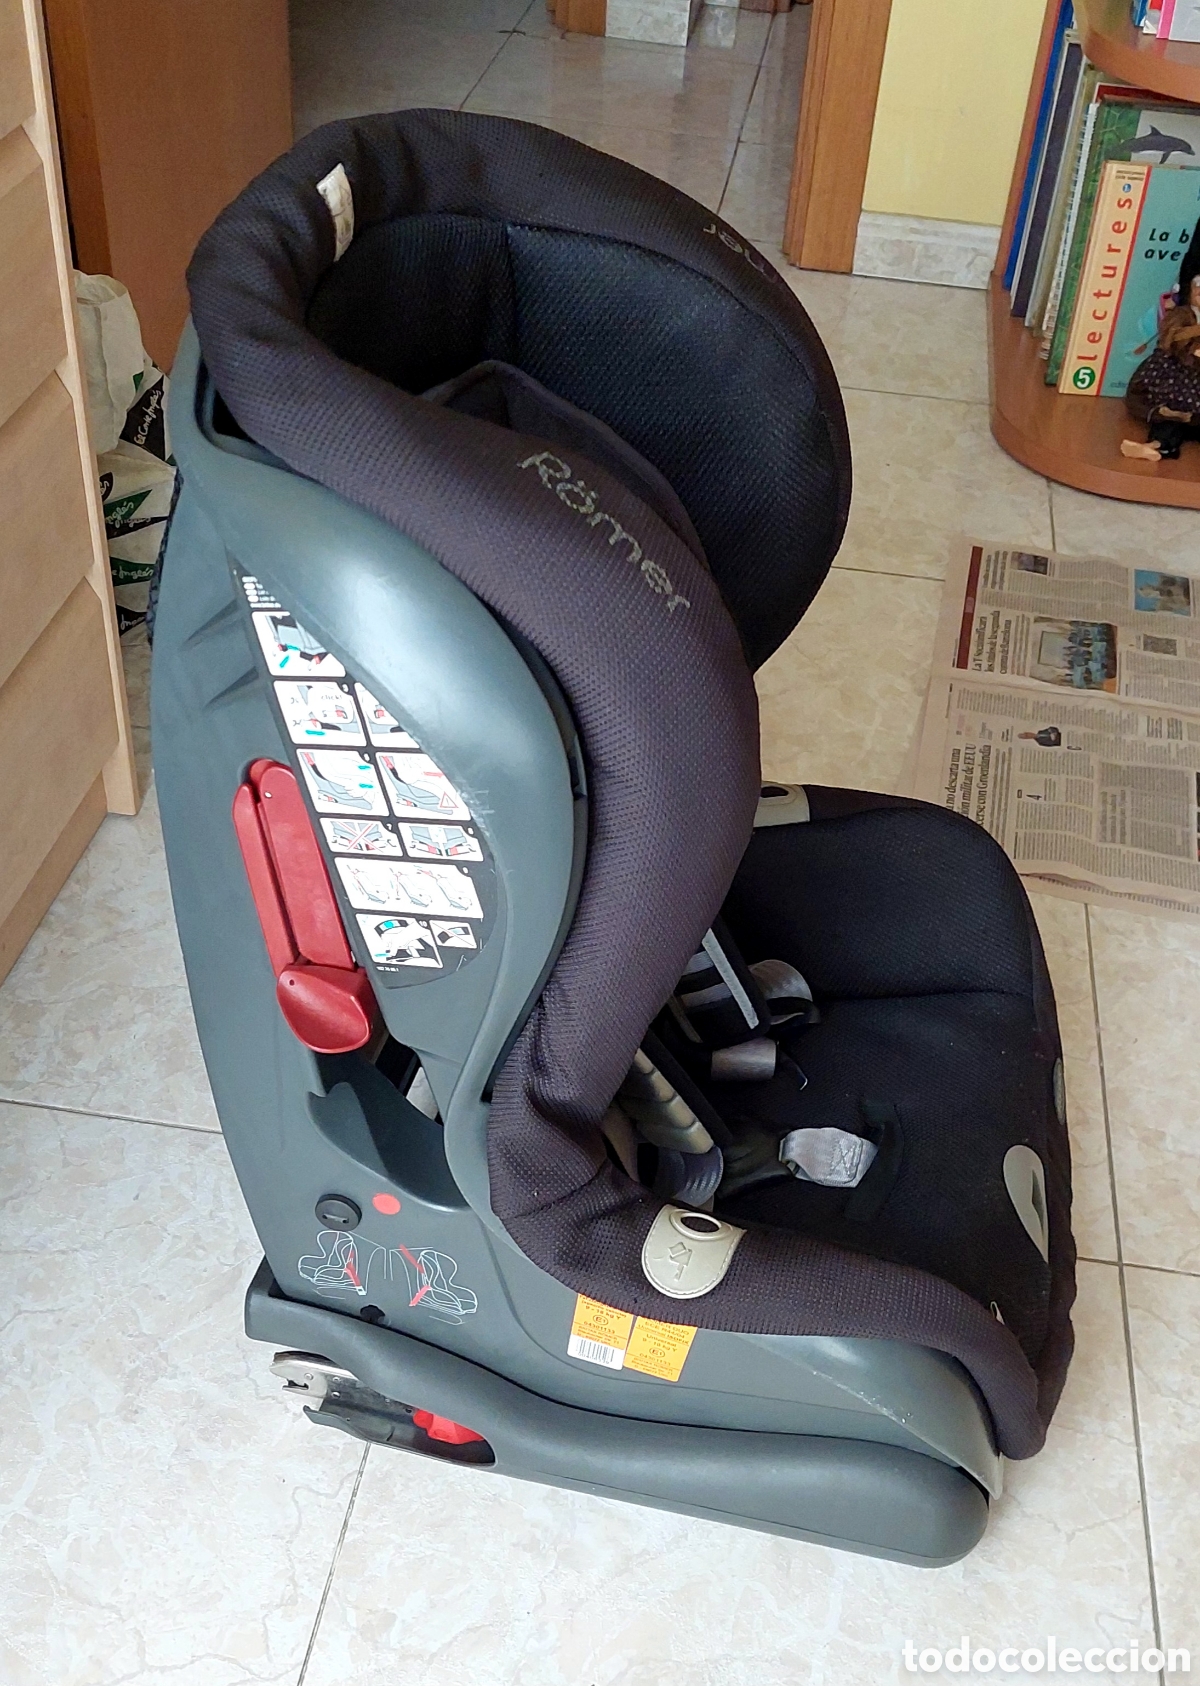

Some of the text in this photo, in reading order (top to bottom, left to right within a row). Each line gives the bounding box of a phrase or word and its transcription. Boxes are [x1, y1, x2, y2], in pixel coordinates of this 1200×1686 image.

[1148, 228, 1170, 242] La
[1144, 248, 1182, 261] ave
[1076, 197, 1133, 361] lectures
[105, 500, 135, 525] nglés
[516, 451, 692, 613] Römer
